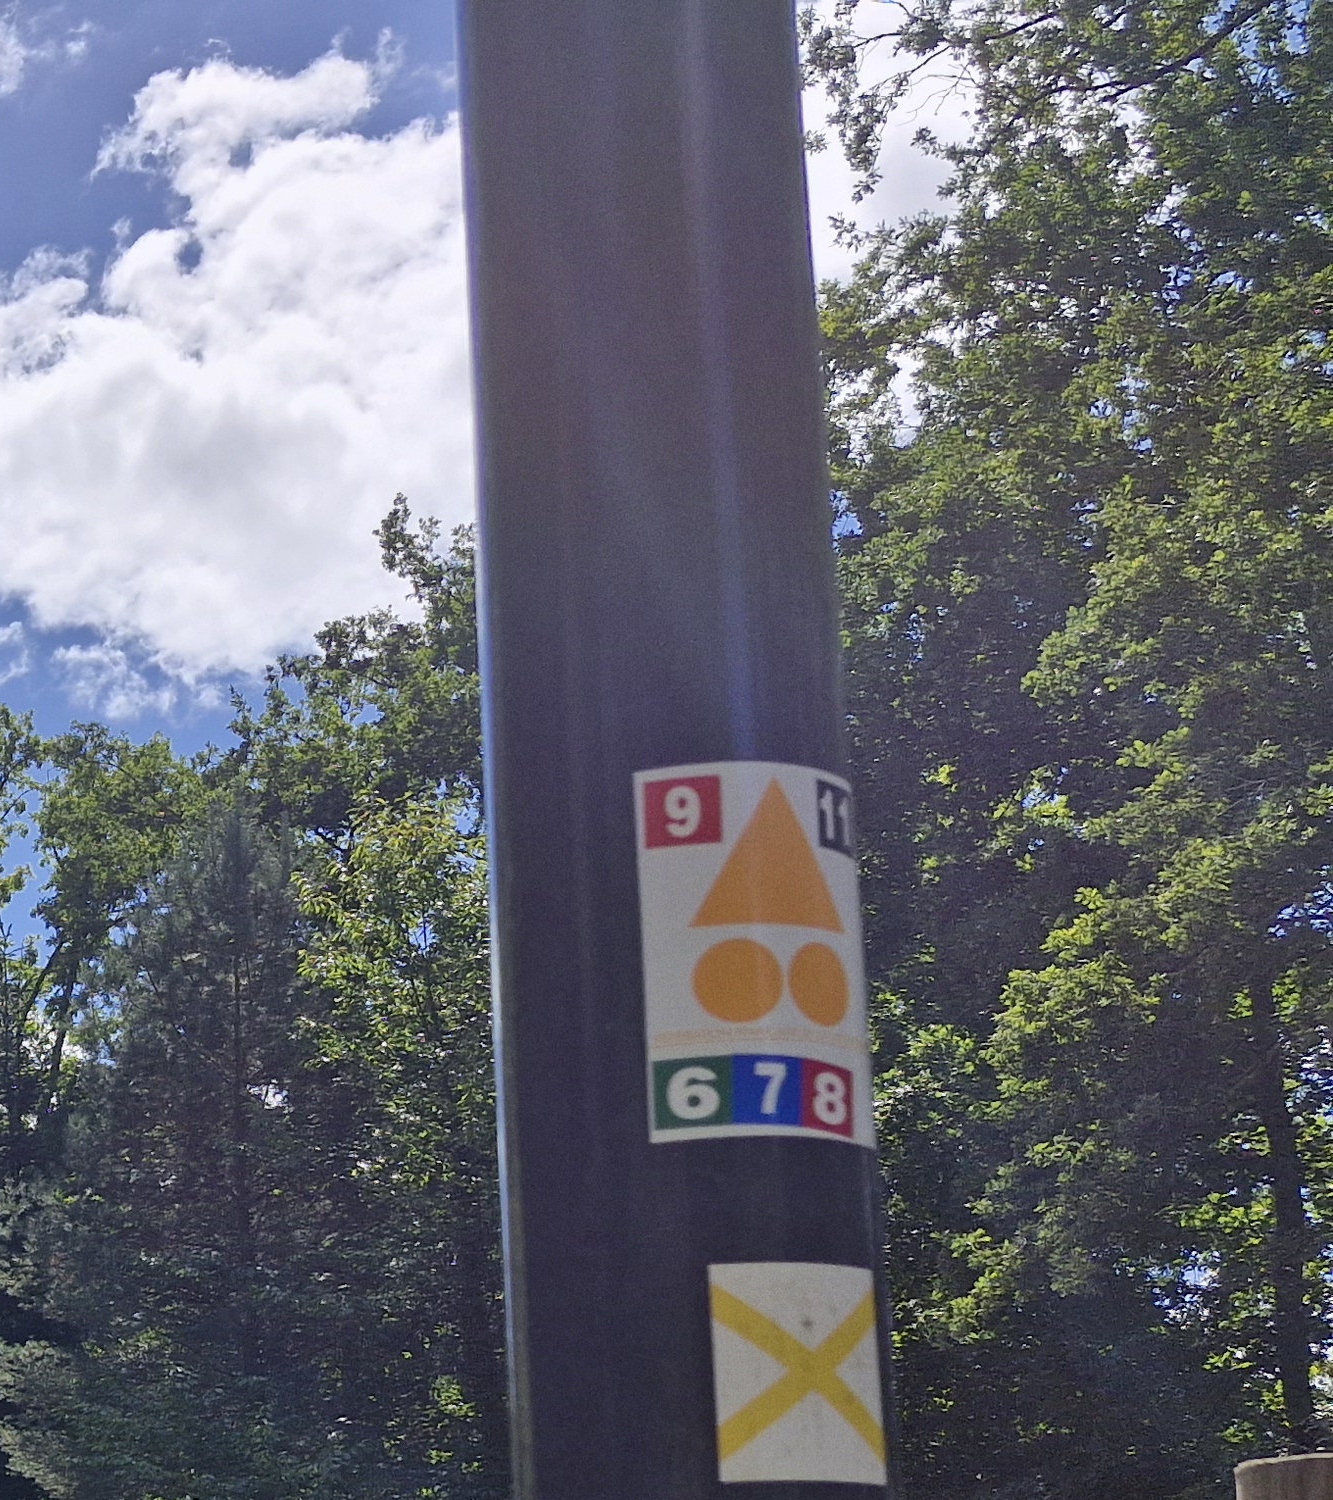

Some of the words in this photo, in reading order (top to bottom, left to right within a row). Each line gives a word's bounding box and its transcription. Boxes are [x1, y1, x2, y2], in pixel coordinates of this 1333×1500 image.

[665, 785, 701, 838] 9
[819, 789, 851, 847] 11
[666, 1066, 720, 1120] 6
[754, 1062, 787, 1114] 7
[813, 1072, 847, 1125] 8
